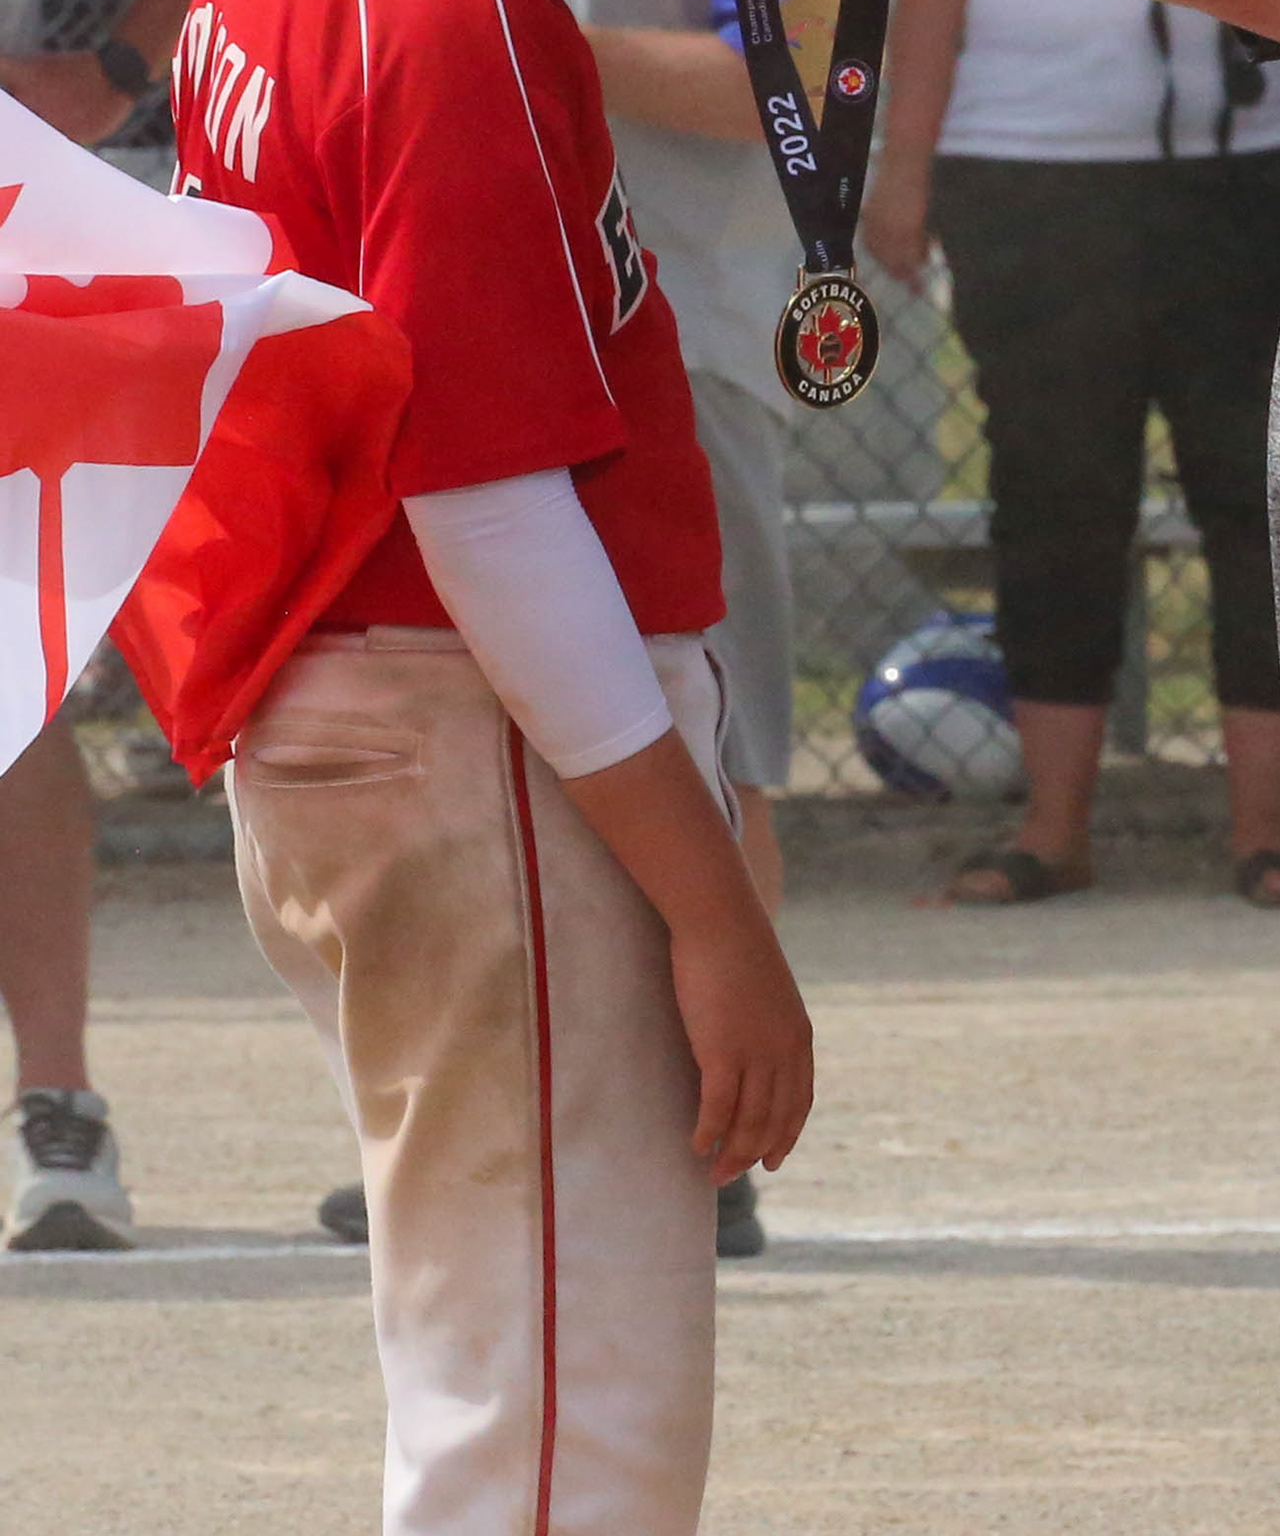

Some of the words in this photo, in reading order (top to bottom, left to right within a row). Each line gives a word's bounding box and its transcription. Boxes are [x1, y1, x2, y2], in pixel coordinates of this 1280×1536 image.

[768, 92, 817, 176] 2022
[792, 283, 865, 322] SOFTBALL
[798, 372, 864, 402] CANADA
